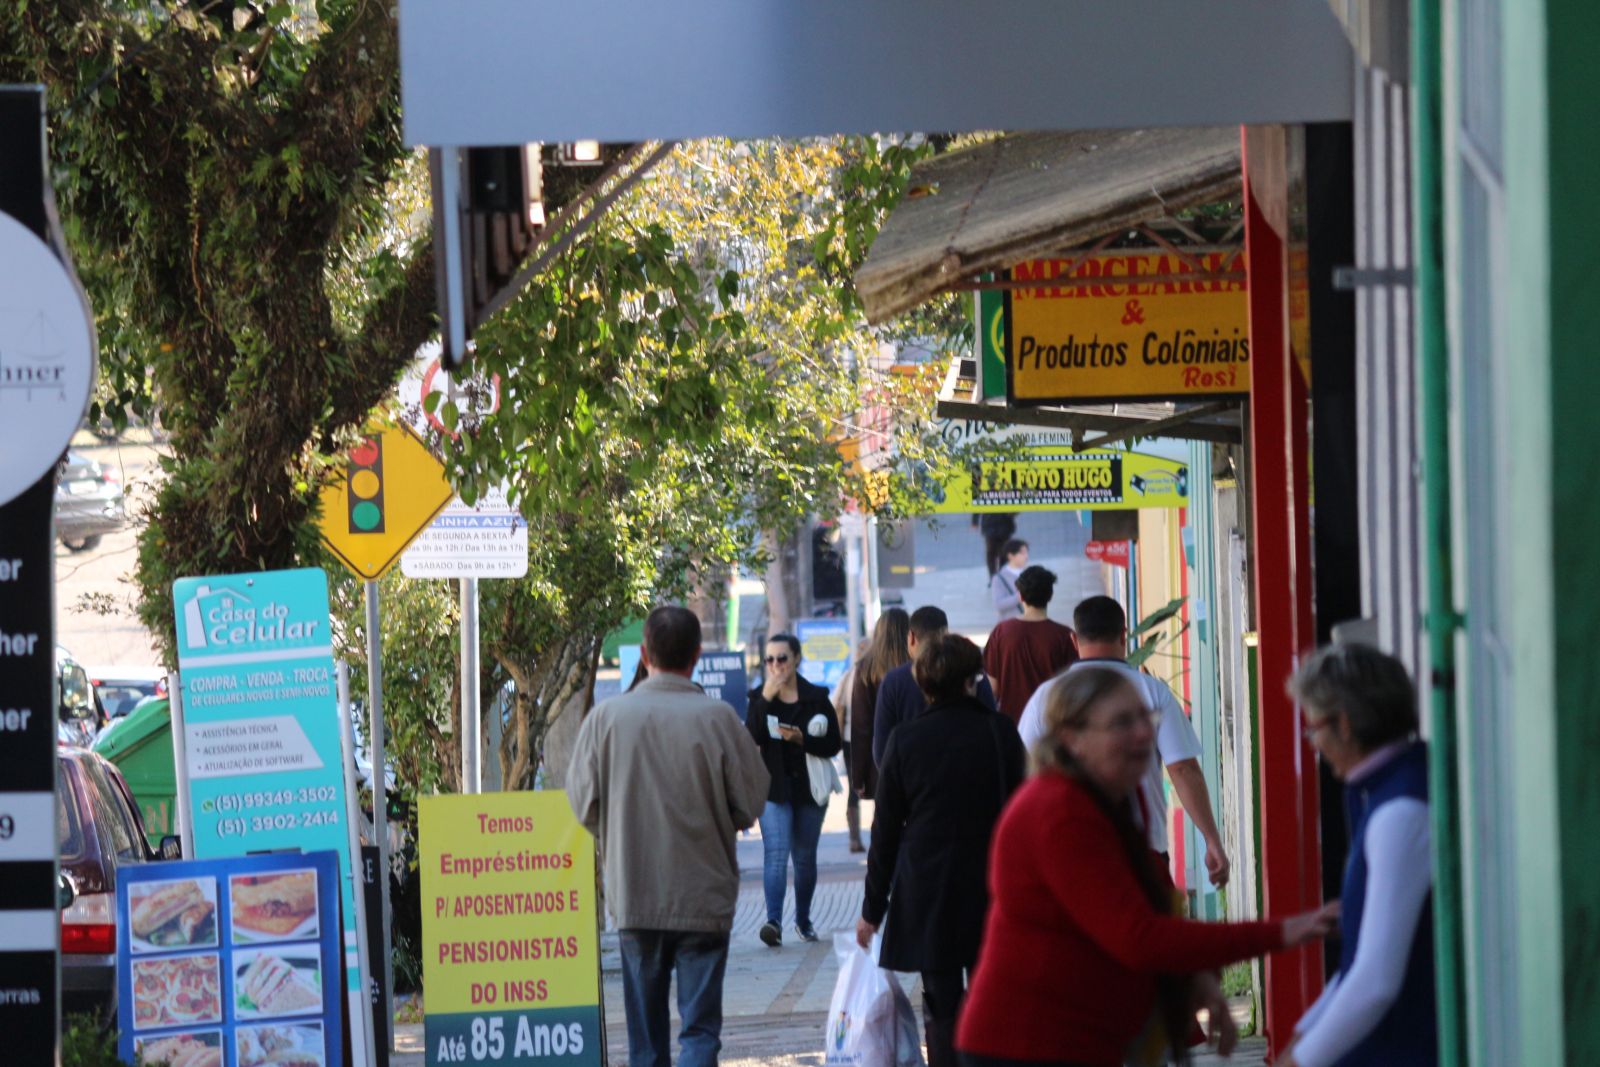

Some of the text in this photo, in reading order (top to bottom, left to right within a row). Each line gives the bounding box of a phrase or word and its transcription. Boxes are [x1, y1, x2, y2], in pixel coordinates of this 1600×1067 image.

[1014, 253, 1247, 300] MERCEARIA
[1121, 300, 1146, 325] &
[1018, 328, 1249, 370] Produtos Colôniais
[1016, 468, 1060, 489] FOTO
[1063, 467, 1112, 489] HUGO
[1061, 489, 1082, 498] TODOS
[1083, 489, 1113, 497] EVENTOS
[432, 517, 479, 527] LINHA
[432, 532, 472, 540] SEGUNDA
[474, 532, 479, 540] A
[482, 532, 507, 540] SEXTA
[466, 544, 480, 552] Das
[209, 602, 289, 623] Casa do
[210, 618, 319, 645] Celular
[190, 667, 328, 692] COMPRA VENDA TROCA
[202, 723, 278, 738] ASSISTÊNCIA TÉCNICA
[203, 740, 283, 755] ACESSÓRIOS EM GERAL
[204, 754, 303, 771] ATUALIZAÇÃO DE SOFTWARE
[215, 786, 336, 814] (51) 99349-3502
[216, 811, 338, 839] (51) 3902-2414
[477, 813, 533, 834] Temos
[440, 850, 573, 878] Empréstimos
[435, 890, 579, 918] P/ APOSENTADOS E
[439, 936, 578, 965] PENSIONISTAS
[471, 979, 548, 1004] DO INSS
[437, 1015, 584, 1063] Até 85 Anos
